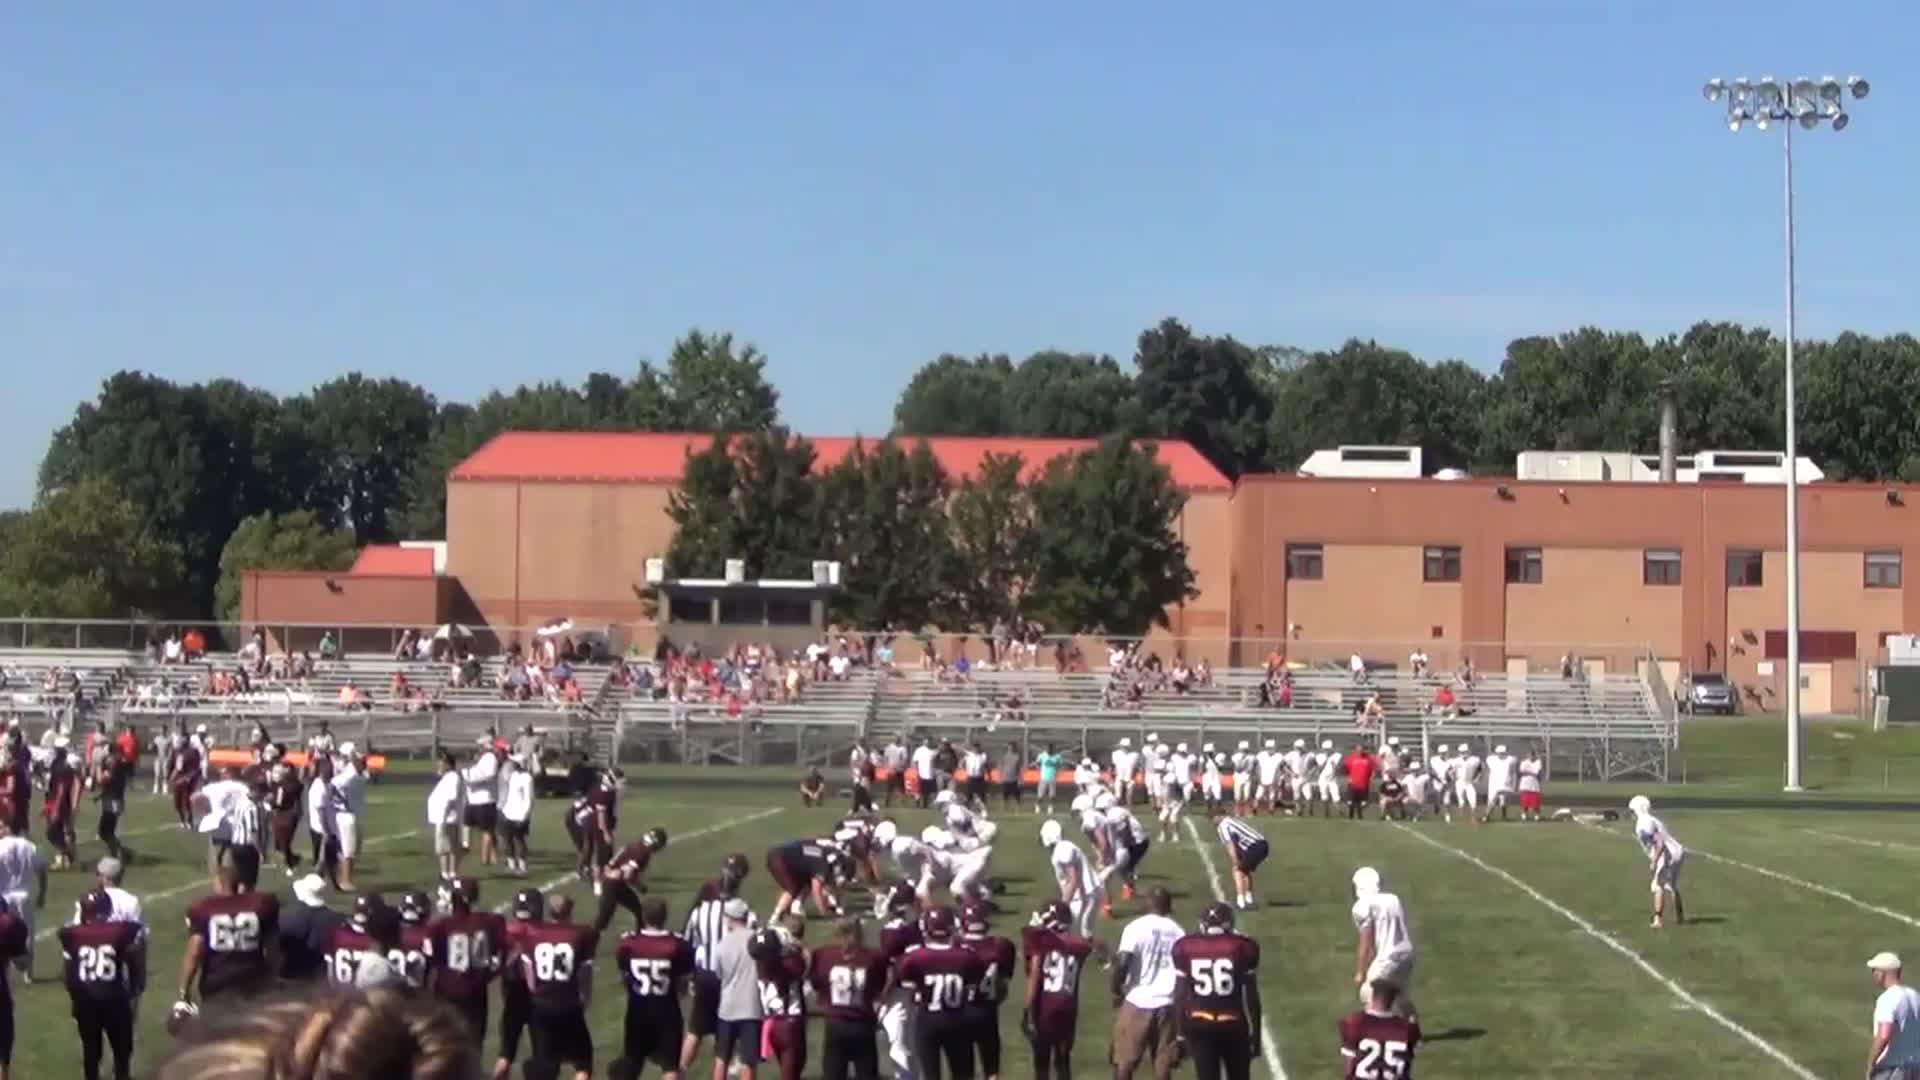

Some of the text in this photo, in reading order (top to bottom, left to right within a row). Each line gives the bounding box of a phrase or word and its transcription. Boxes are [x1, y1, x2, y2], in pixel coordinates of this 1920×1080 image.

[77, 945, 117, 982] 26
[533, 942, 575, 982] 83
[629, 958, 673, 996] 55
[1190, 958, 1234, 996] 56
[924, 973, 963, 1012] 70
[1355, 1038, 1408, 1080] 25
